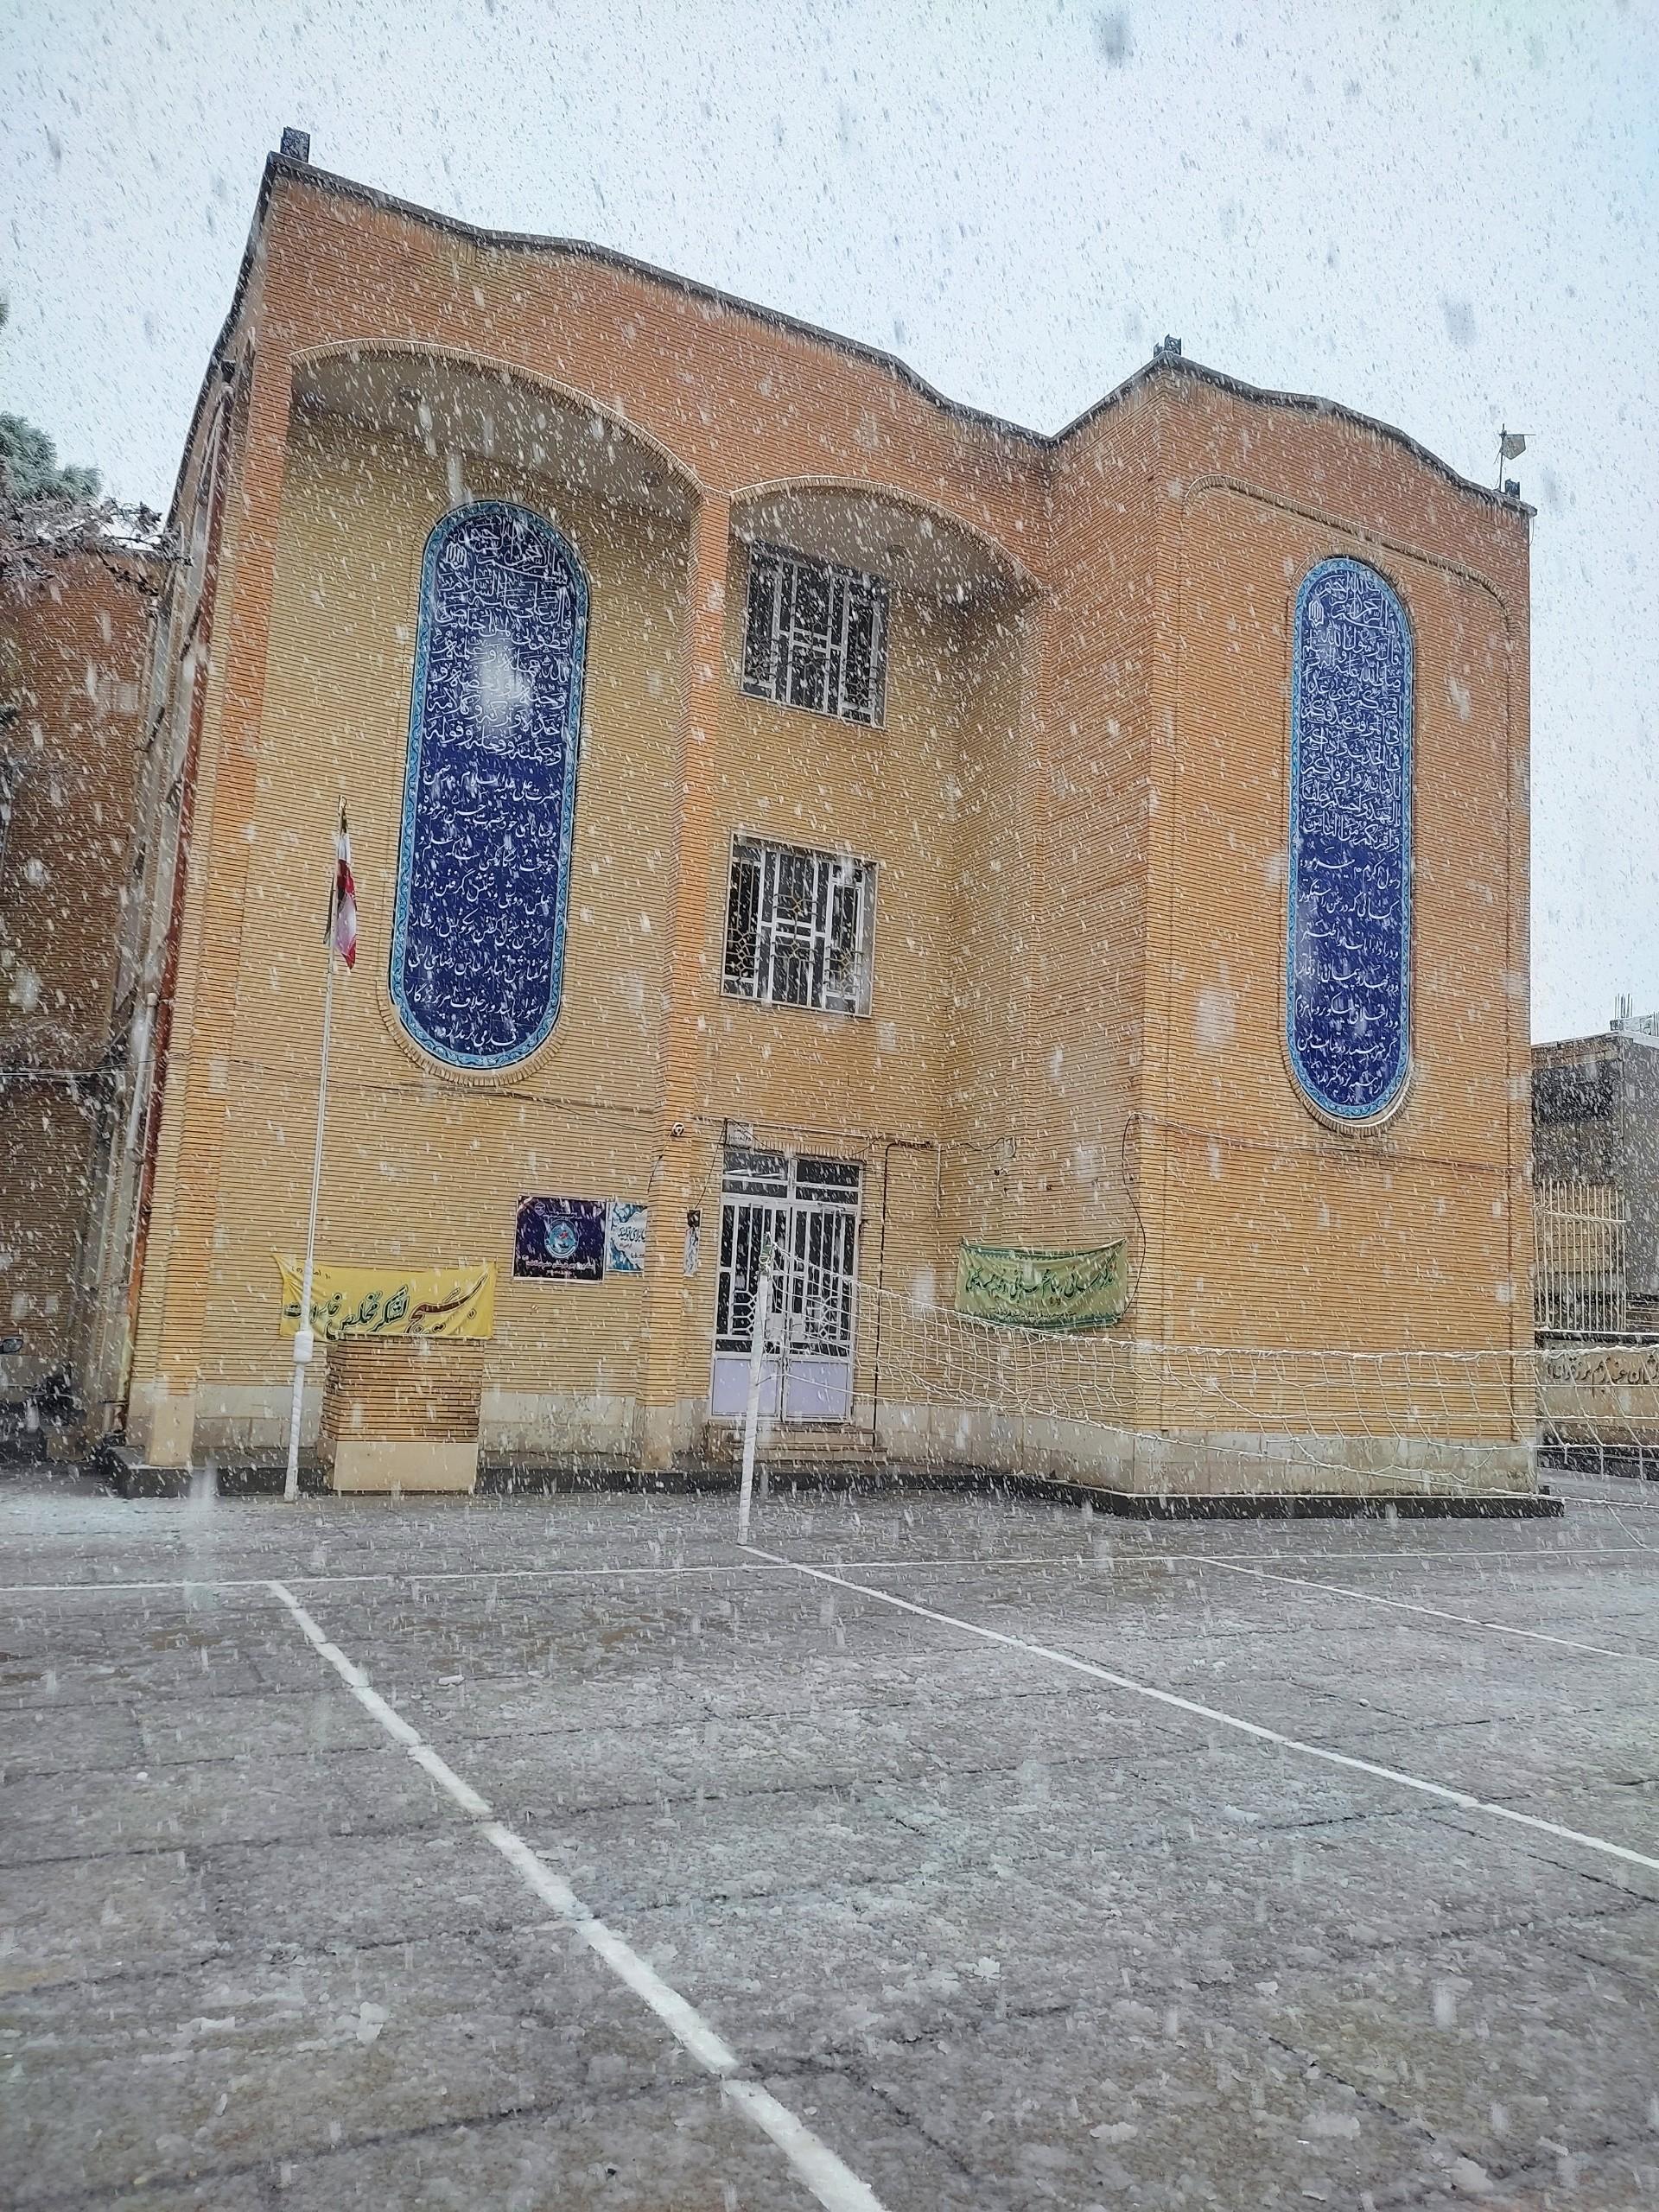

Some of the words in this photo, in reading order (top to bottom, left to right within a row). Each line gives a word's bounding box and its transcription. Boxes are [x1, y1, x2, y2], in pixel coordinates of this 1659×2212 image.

[525, 782, 561, 804] حضرت
[283, 1292, 342, 1324] خدات
[325, 1290, 383, 1340] مخلص
[366, 1284, 410, 1332] لشکر
[404, 1269, 489, 1334] بسیج
